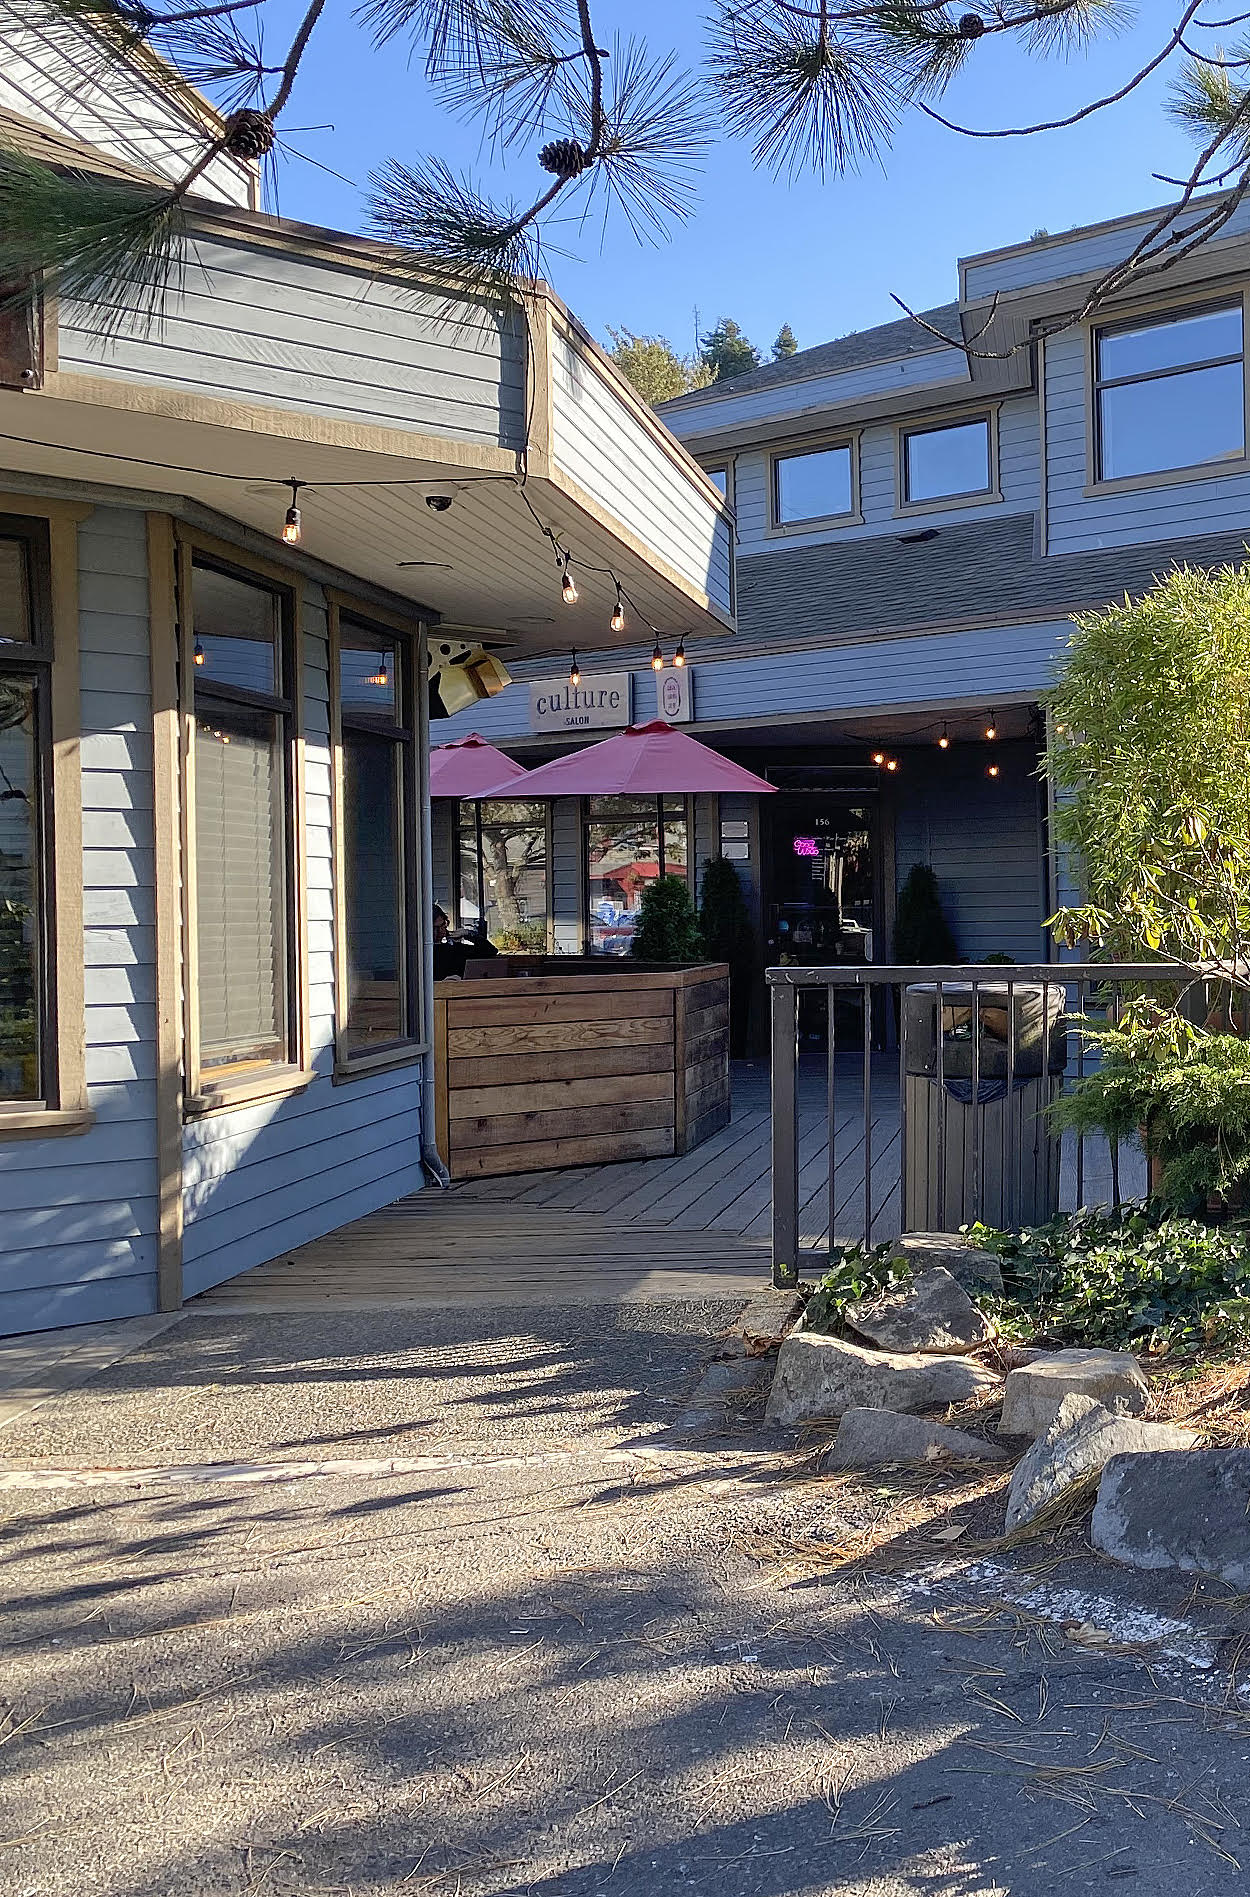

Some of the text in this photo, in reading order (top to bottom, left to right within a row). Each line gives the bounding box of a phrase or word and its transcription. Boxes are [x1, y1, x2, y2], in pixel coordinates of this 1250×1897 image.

[537, 686, 620, 715] culture
[566, 716, 590, 726] SALON
[815, 818, 830, 826] 156
